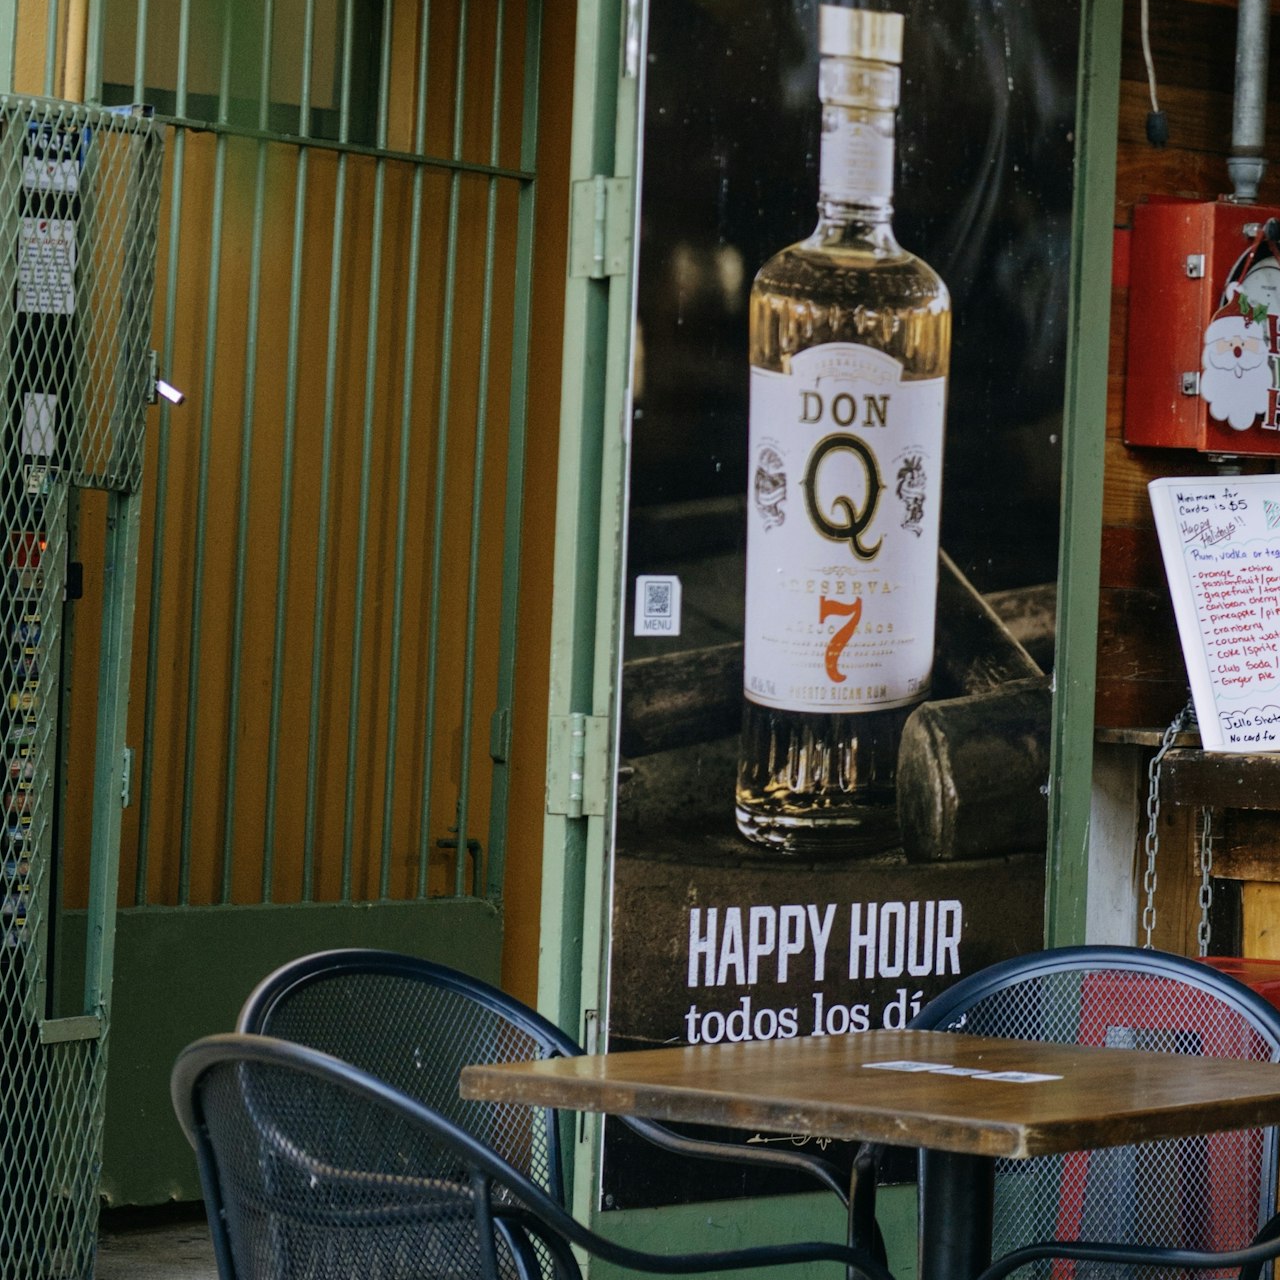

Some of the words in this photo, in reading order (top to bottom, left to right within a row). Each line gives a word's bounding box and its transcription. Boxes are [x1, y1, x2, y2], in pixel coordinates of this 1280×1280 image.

[798, 391, 892, 428] DON
[798, 432, 888, 564] Q
[1176, 493, 1216, 503] Minimum
[1223, 488, 1239, 500] for
[1179, 504, 1210, 516] Cards
[1228, 500, 1249, 512] $5
[1181, 518, 1213, 536] Happy
[1220, 549, 1248, 560] vodka
[1198, 570, 1236, 580] orange
[1210, 609, 1258, 624] pineapple
[643, 620, 673, 631] MENU
[1213, 622, 1265, 635] cranberry
[818, 595, 863, 683] 7
[1215, 634, 1256, 646] coconut
[1217, 664, 1241, 674] Club
[1245, 660, 1273, 671] Soda
[1221, 673, 1254, 688] Ginger
[1258, 671, 1276, 680] Ale
[831, 685, 862, 701] RICAN
[866, 685, 888, 700] RUM
[1222, 716, 1252, 730] Jello
[1230, 734, 1242, 744] No
[1243, 731, 1261, 742] card
[1262, 729, 1276, 744] for
[687, 904, 837, 989] HAPPY
[850, 899, 962, 978] HOUR
[684, 991, 799, 1046] todos
[811, 992, 870, 1037] los
